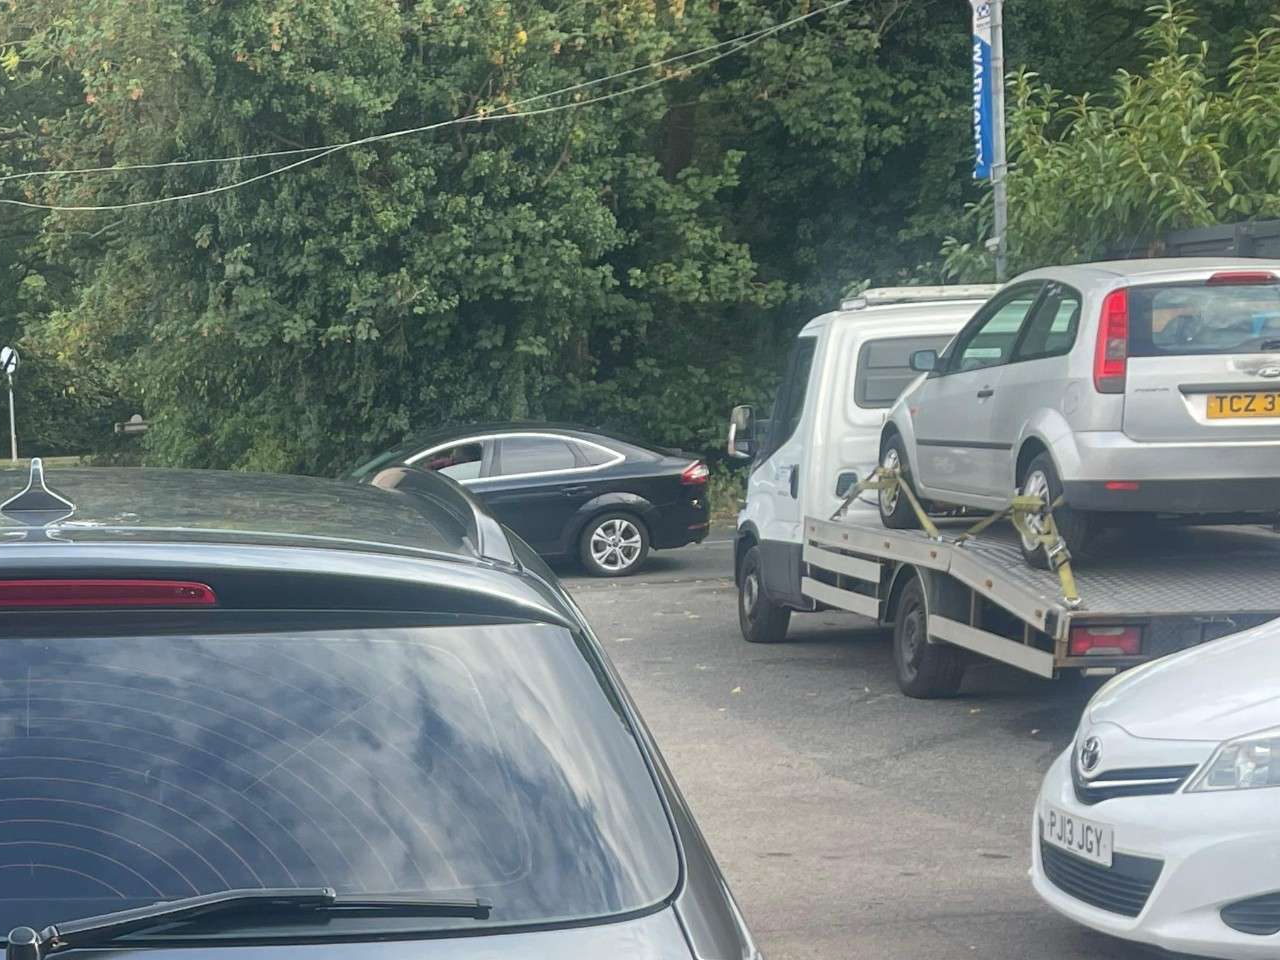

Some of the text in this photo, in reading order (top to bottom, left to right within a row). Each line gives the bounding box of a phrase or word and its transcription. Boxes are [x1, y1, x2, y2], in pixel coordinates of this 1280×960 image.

[972, 41, 985, 166] WARRANTY
[1216, 394, 1280, 412] TCZ 3
[1049, 810, 1103, 857] PJ13 JGY
